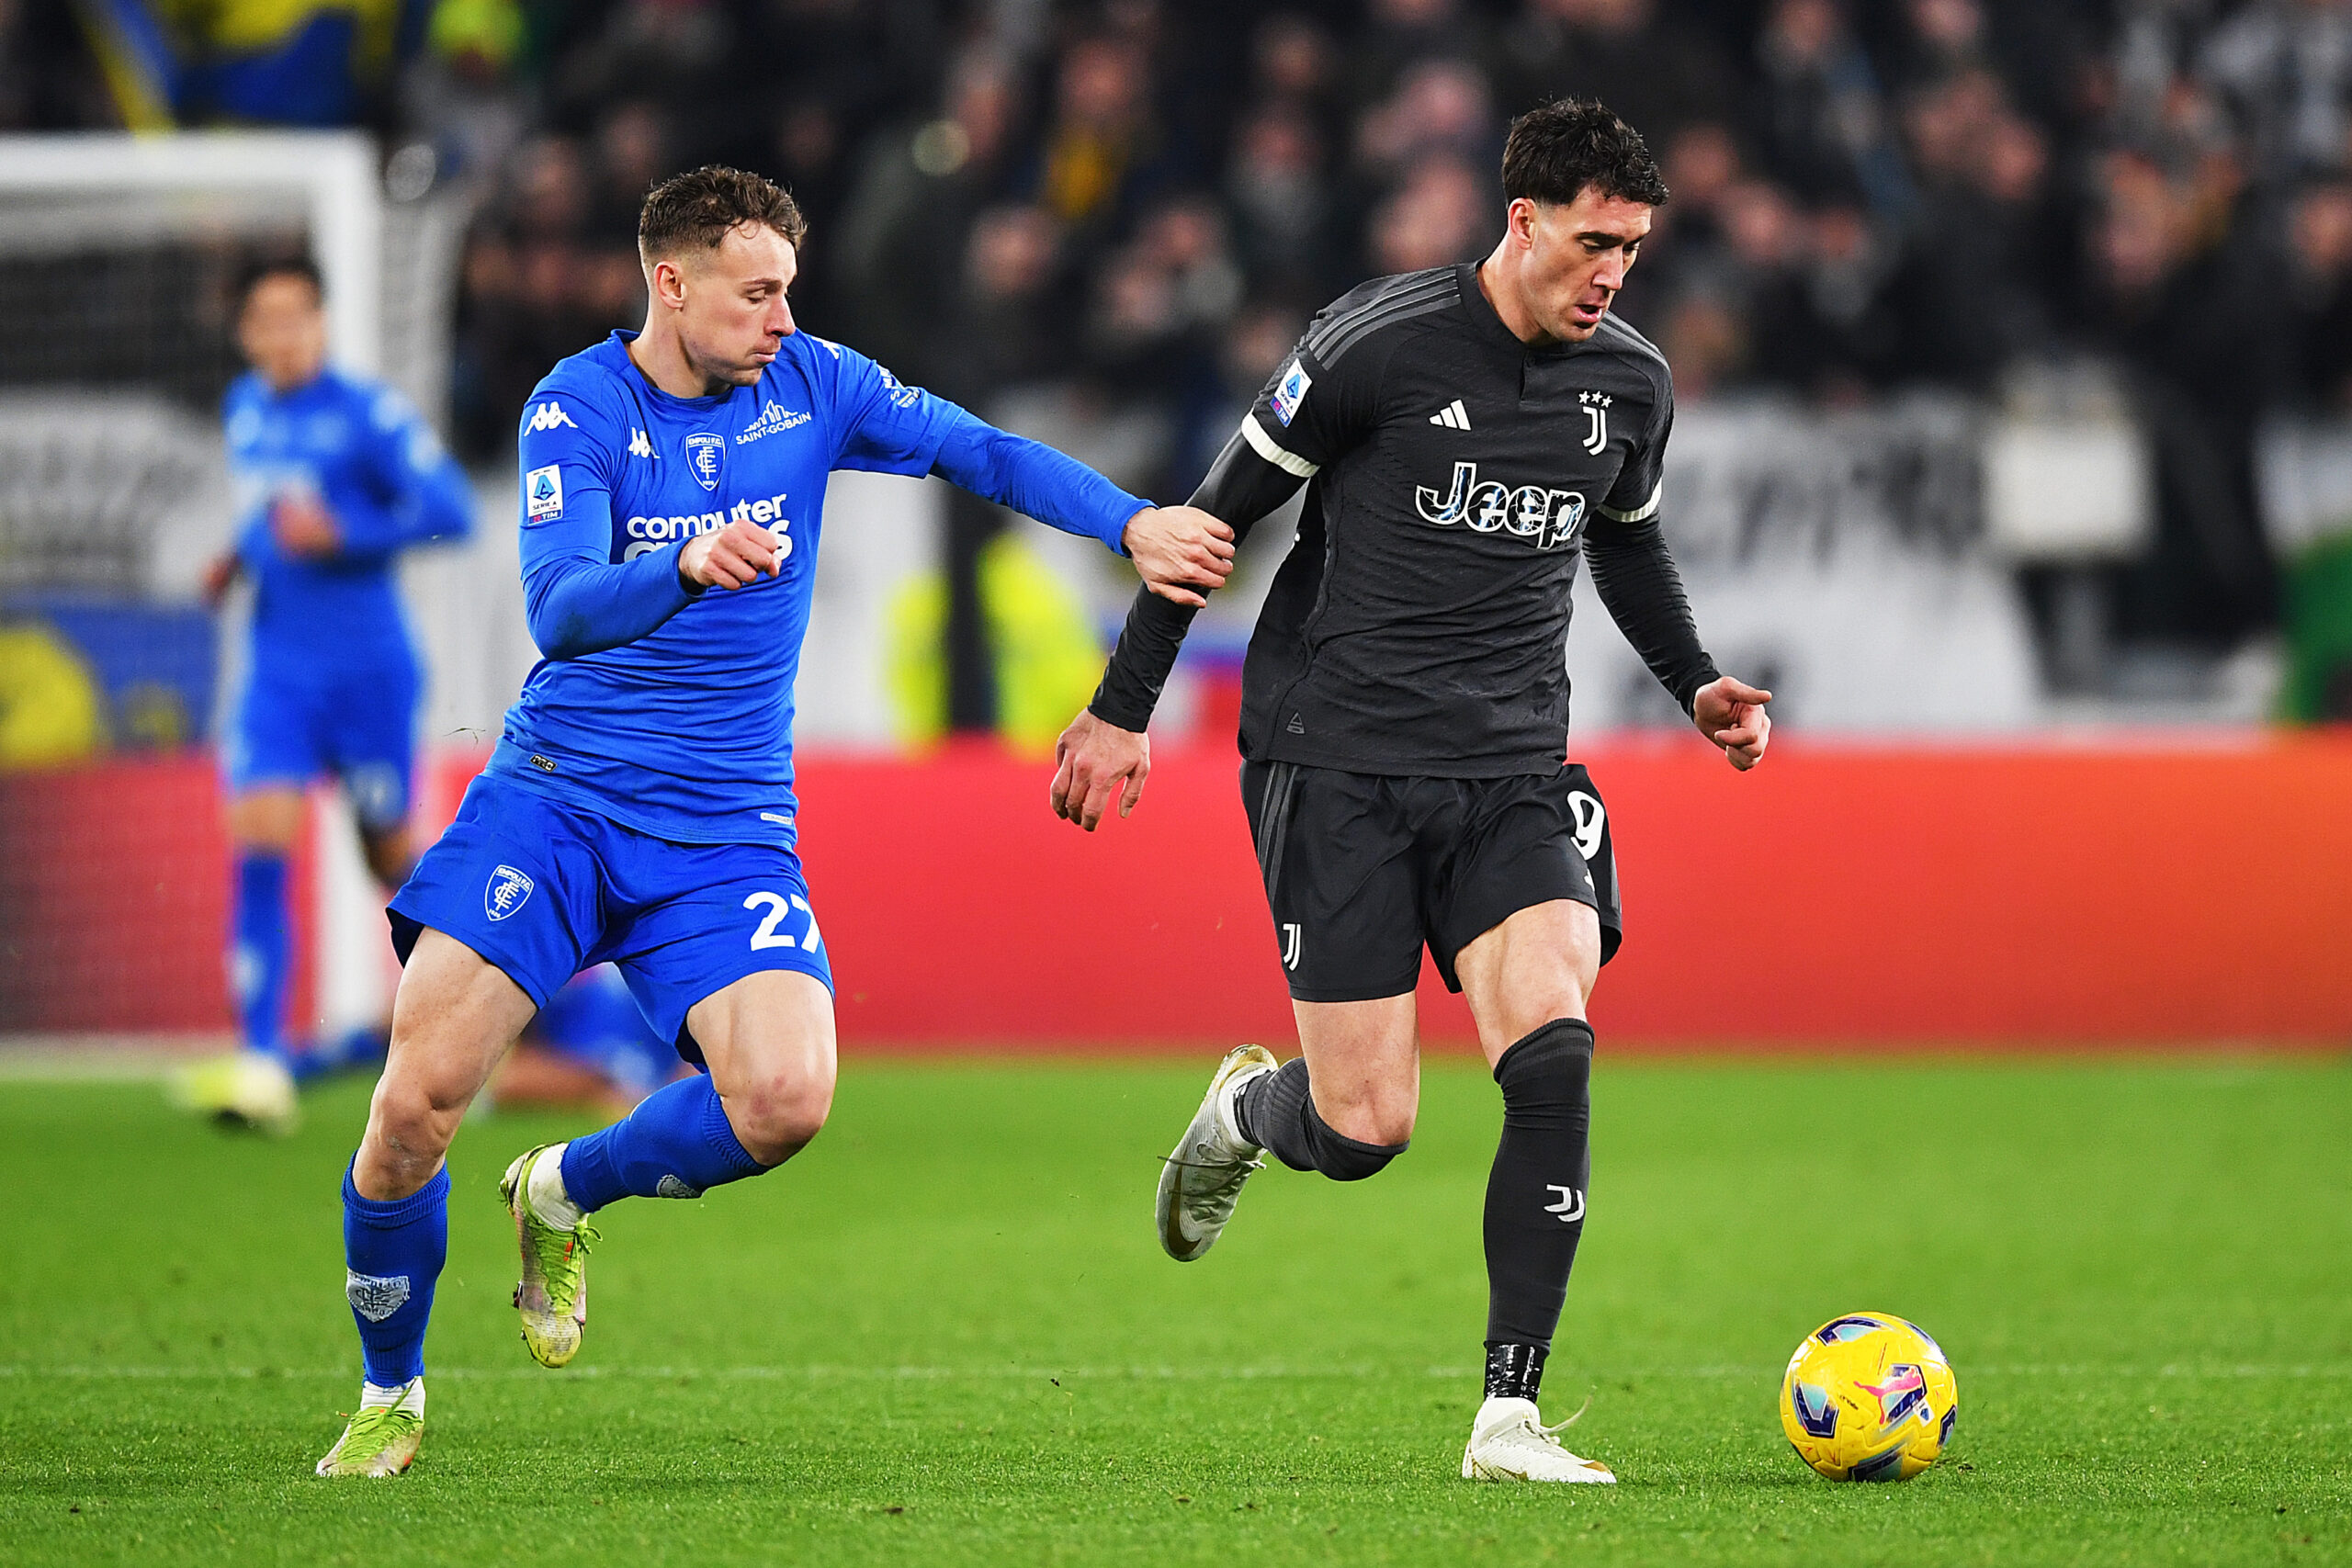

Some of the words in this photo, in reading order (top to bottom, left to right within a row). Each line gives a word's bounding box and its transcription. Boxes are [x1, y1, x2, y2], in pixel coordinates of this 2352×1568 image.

[688, 436, 711, 446] EMPOLI
[736, 412, 812, 445] SAINT-GOBAIN
[533, 502, 550, 510] SERIE
[542, 511, 560, 521] TIM
[627, 493, 787, 540] computer
[1416, 461, 1586, 550] Jeep
[1566, 790, 1605, 861] 9
[497, 867, 523, 883] EMPOLI
[742, 891, 820, 954] 27
